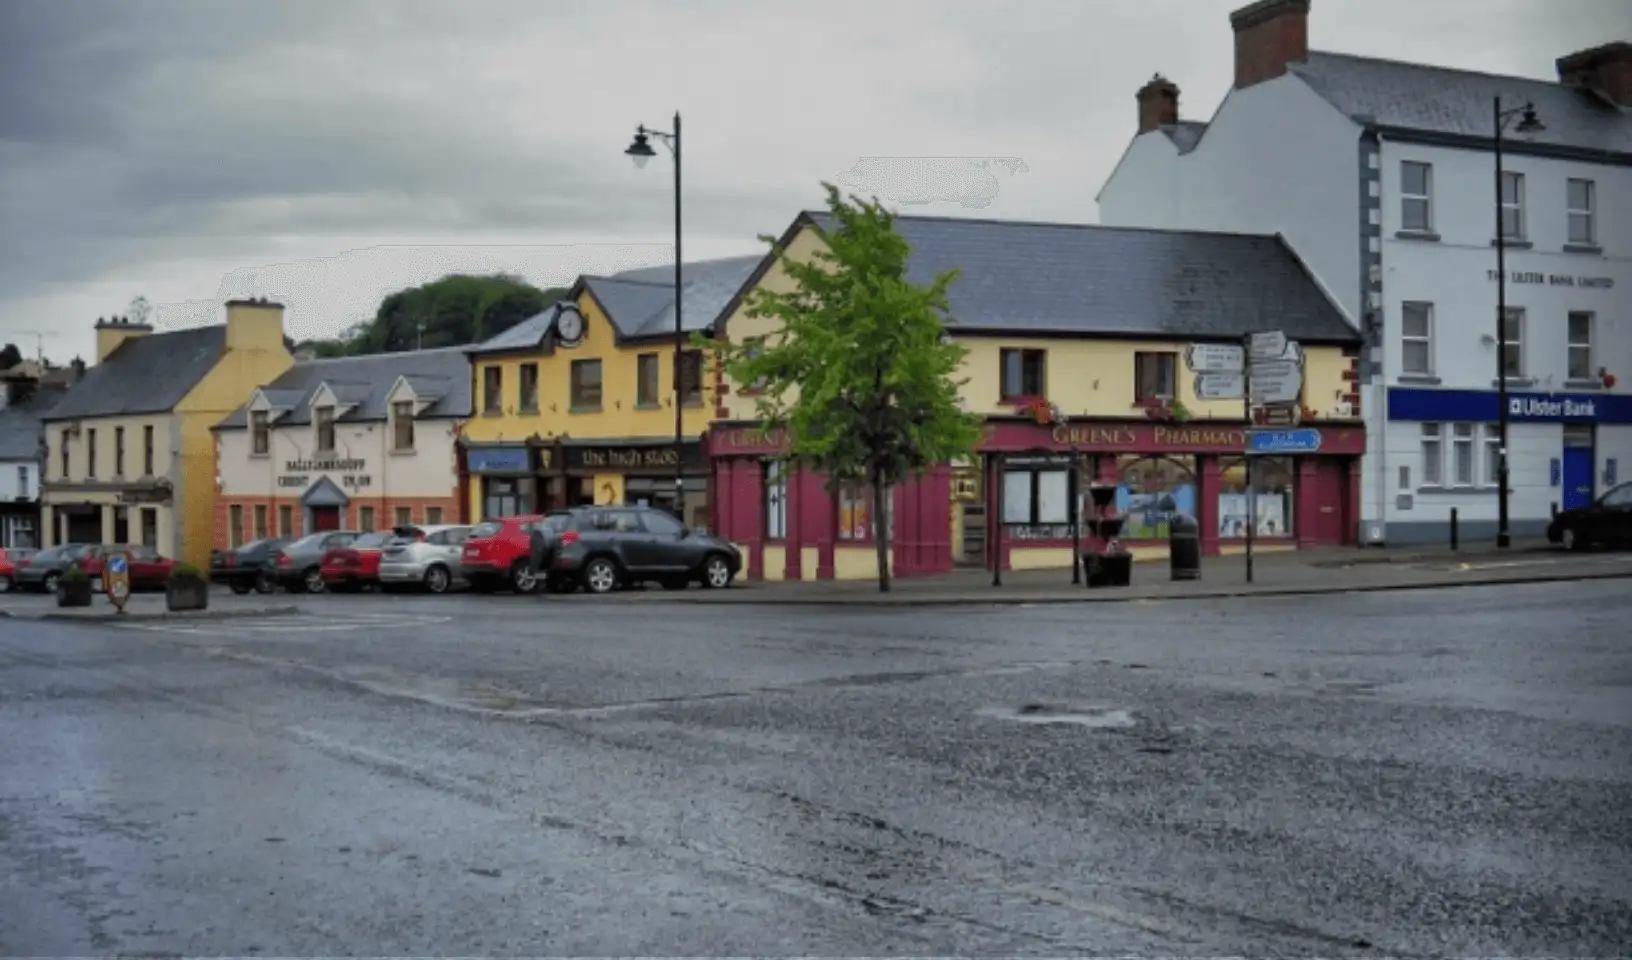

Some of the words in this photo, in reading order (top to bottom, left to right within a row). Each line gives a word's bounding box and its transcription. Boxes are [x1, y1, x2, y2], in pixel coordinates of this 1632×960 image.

[1549, 275, 1573, 285] BANK
[1524, 399, 1560, 416] Ulster
[1564, 400, 1595, 416] Bank
[1052, 424, 1135, 444] GREENE'S
[1154, 426, 1246, 445] PHARMACY
[582, 449, 606, 464] the
[609, 449, 641, 466] high
